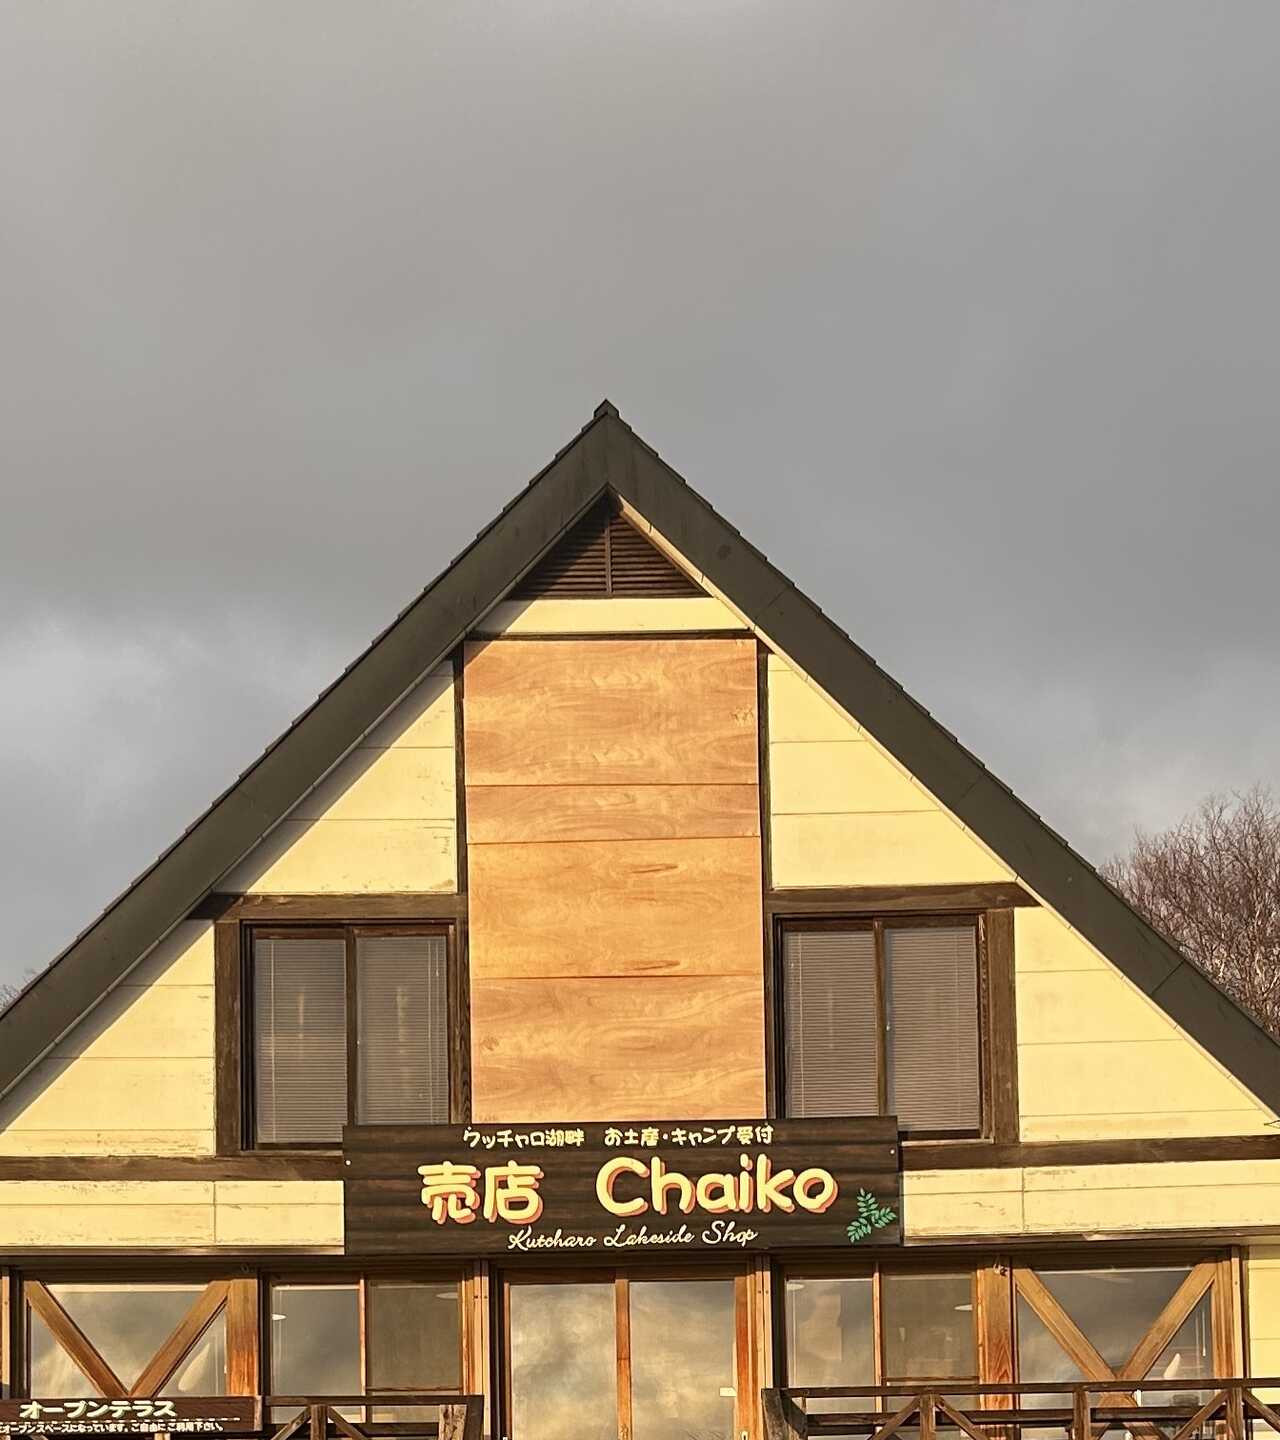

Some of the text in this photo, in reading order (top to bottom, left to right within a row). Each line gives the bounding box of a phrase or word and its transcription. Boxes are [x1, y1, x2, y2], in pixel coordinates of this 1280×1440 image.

[418, 1153, 839, 1225] 売店 Chaiko
[507, 1220, 759, 1251] Kutcharo Lakeside Shop
